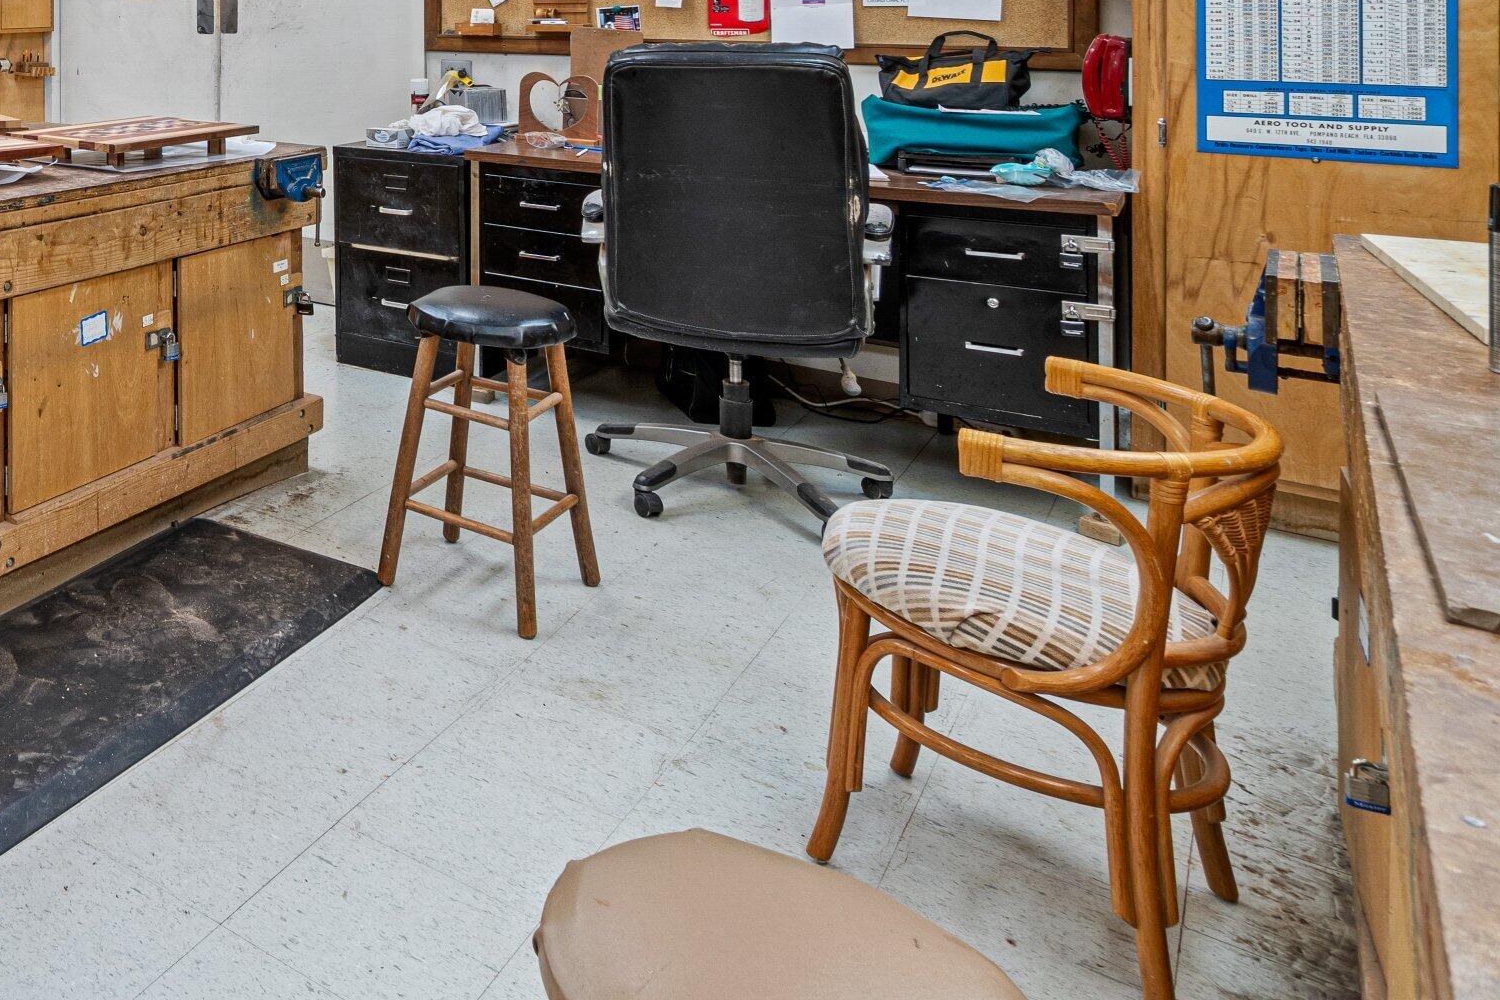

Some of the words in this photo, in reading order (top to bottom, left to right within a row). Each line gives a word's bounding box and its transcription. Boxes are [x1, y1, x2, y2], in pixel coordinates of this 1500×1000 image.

[1253, 119, 1281, 128] AERO
[1285, 121, 1313, 129] TOOL
[1349, 124, 1390, 133] SUPPLY
